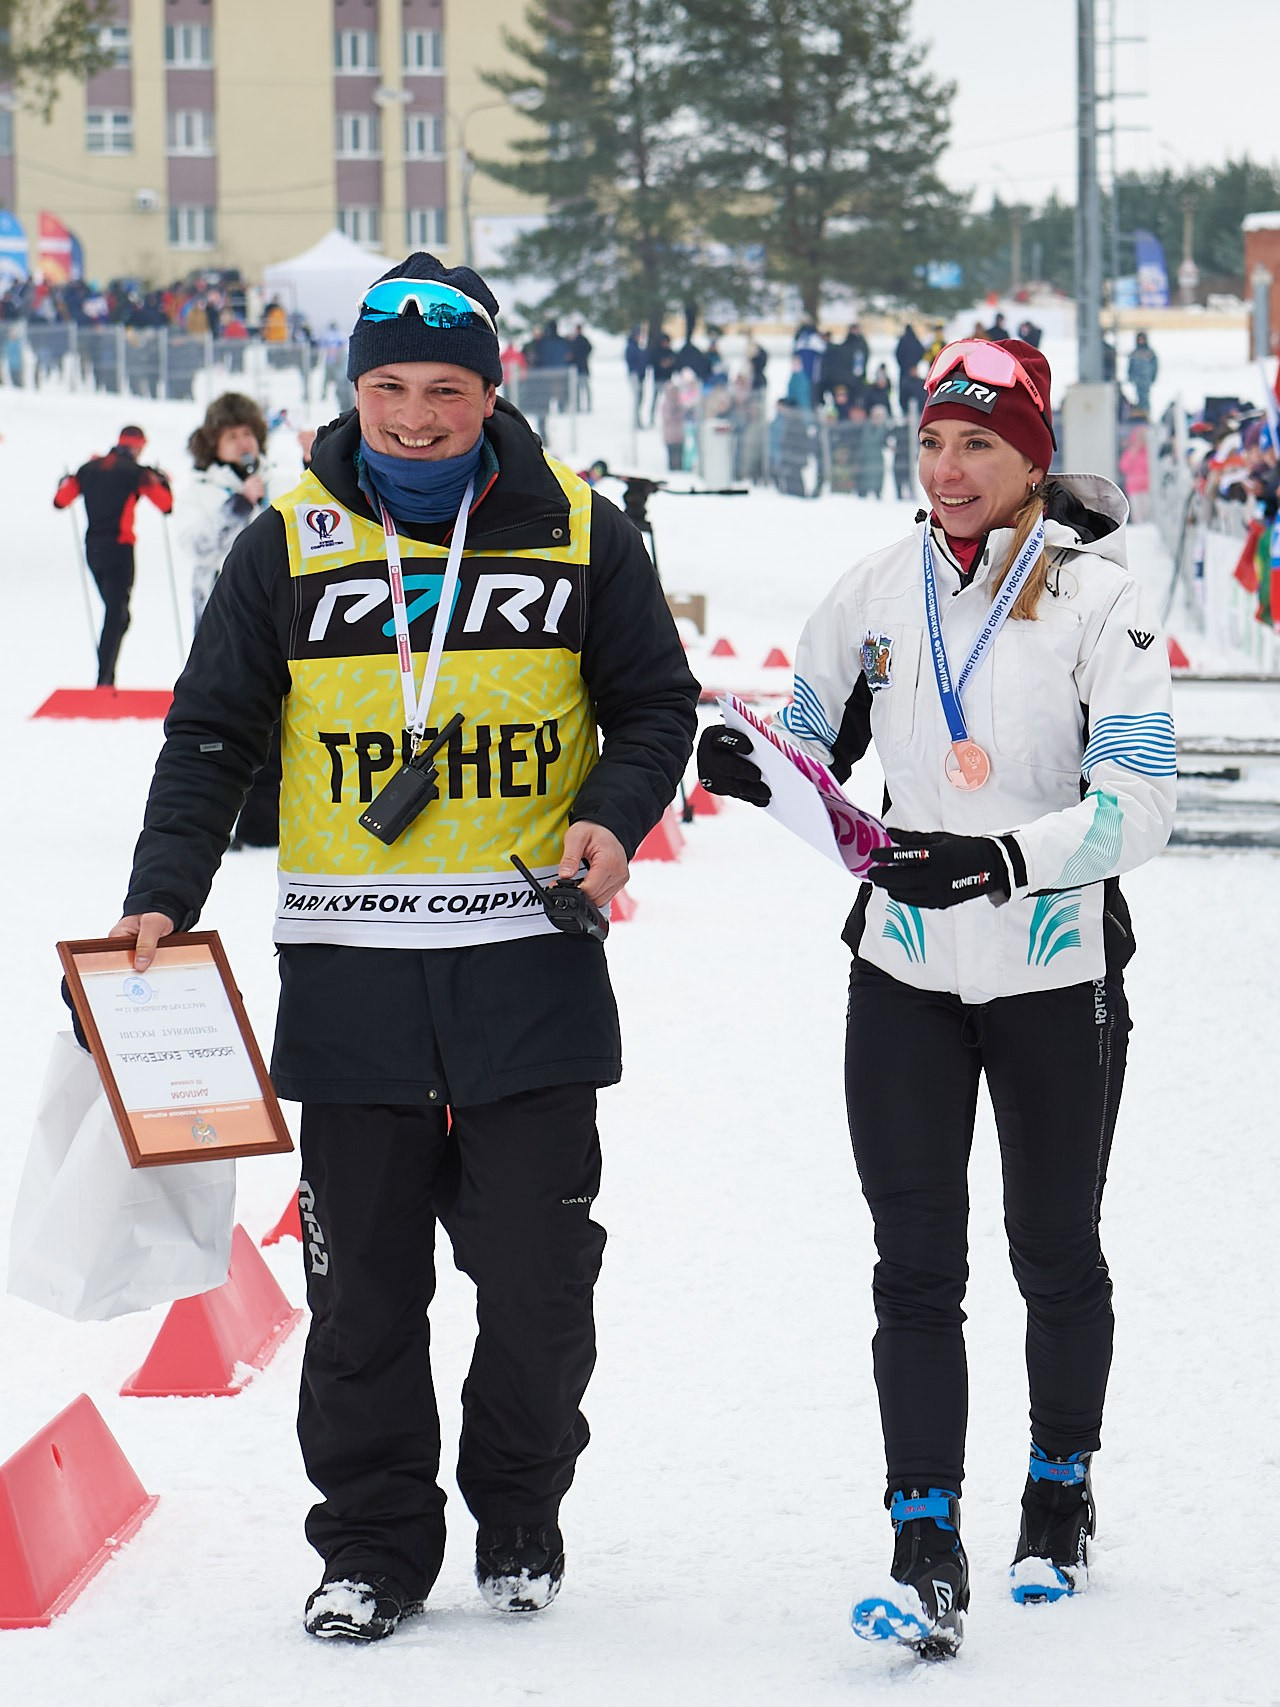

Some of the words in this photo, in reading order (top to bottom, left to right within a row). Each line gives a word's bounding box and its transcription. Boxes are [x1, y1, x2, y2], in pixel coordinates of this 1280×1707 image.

[988, 593, 1011, 628] СПОРТА
[1006, 538, 1040, 594] РОССИЙСКОЙ
[284, 893, 324, 911] PARI
[327, 894, 422, 914] КУБОК
[426, 889, 543, 915] СОДРУЖ
[119, 1029, 156, 1039] РОССИИ
[162, 1025, 218, 1037] ЧЕМПИОНАТ
[121, 1050, 182, 1063] ЕКАТЕРИНА
[170, 1088, 209, 1099] ДИПЛОМ
[562, 1196, 592, 1205] CRAFT
[1077, 1527, 1087, 1561] omon
